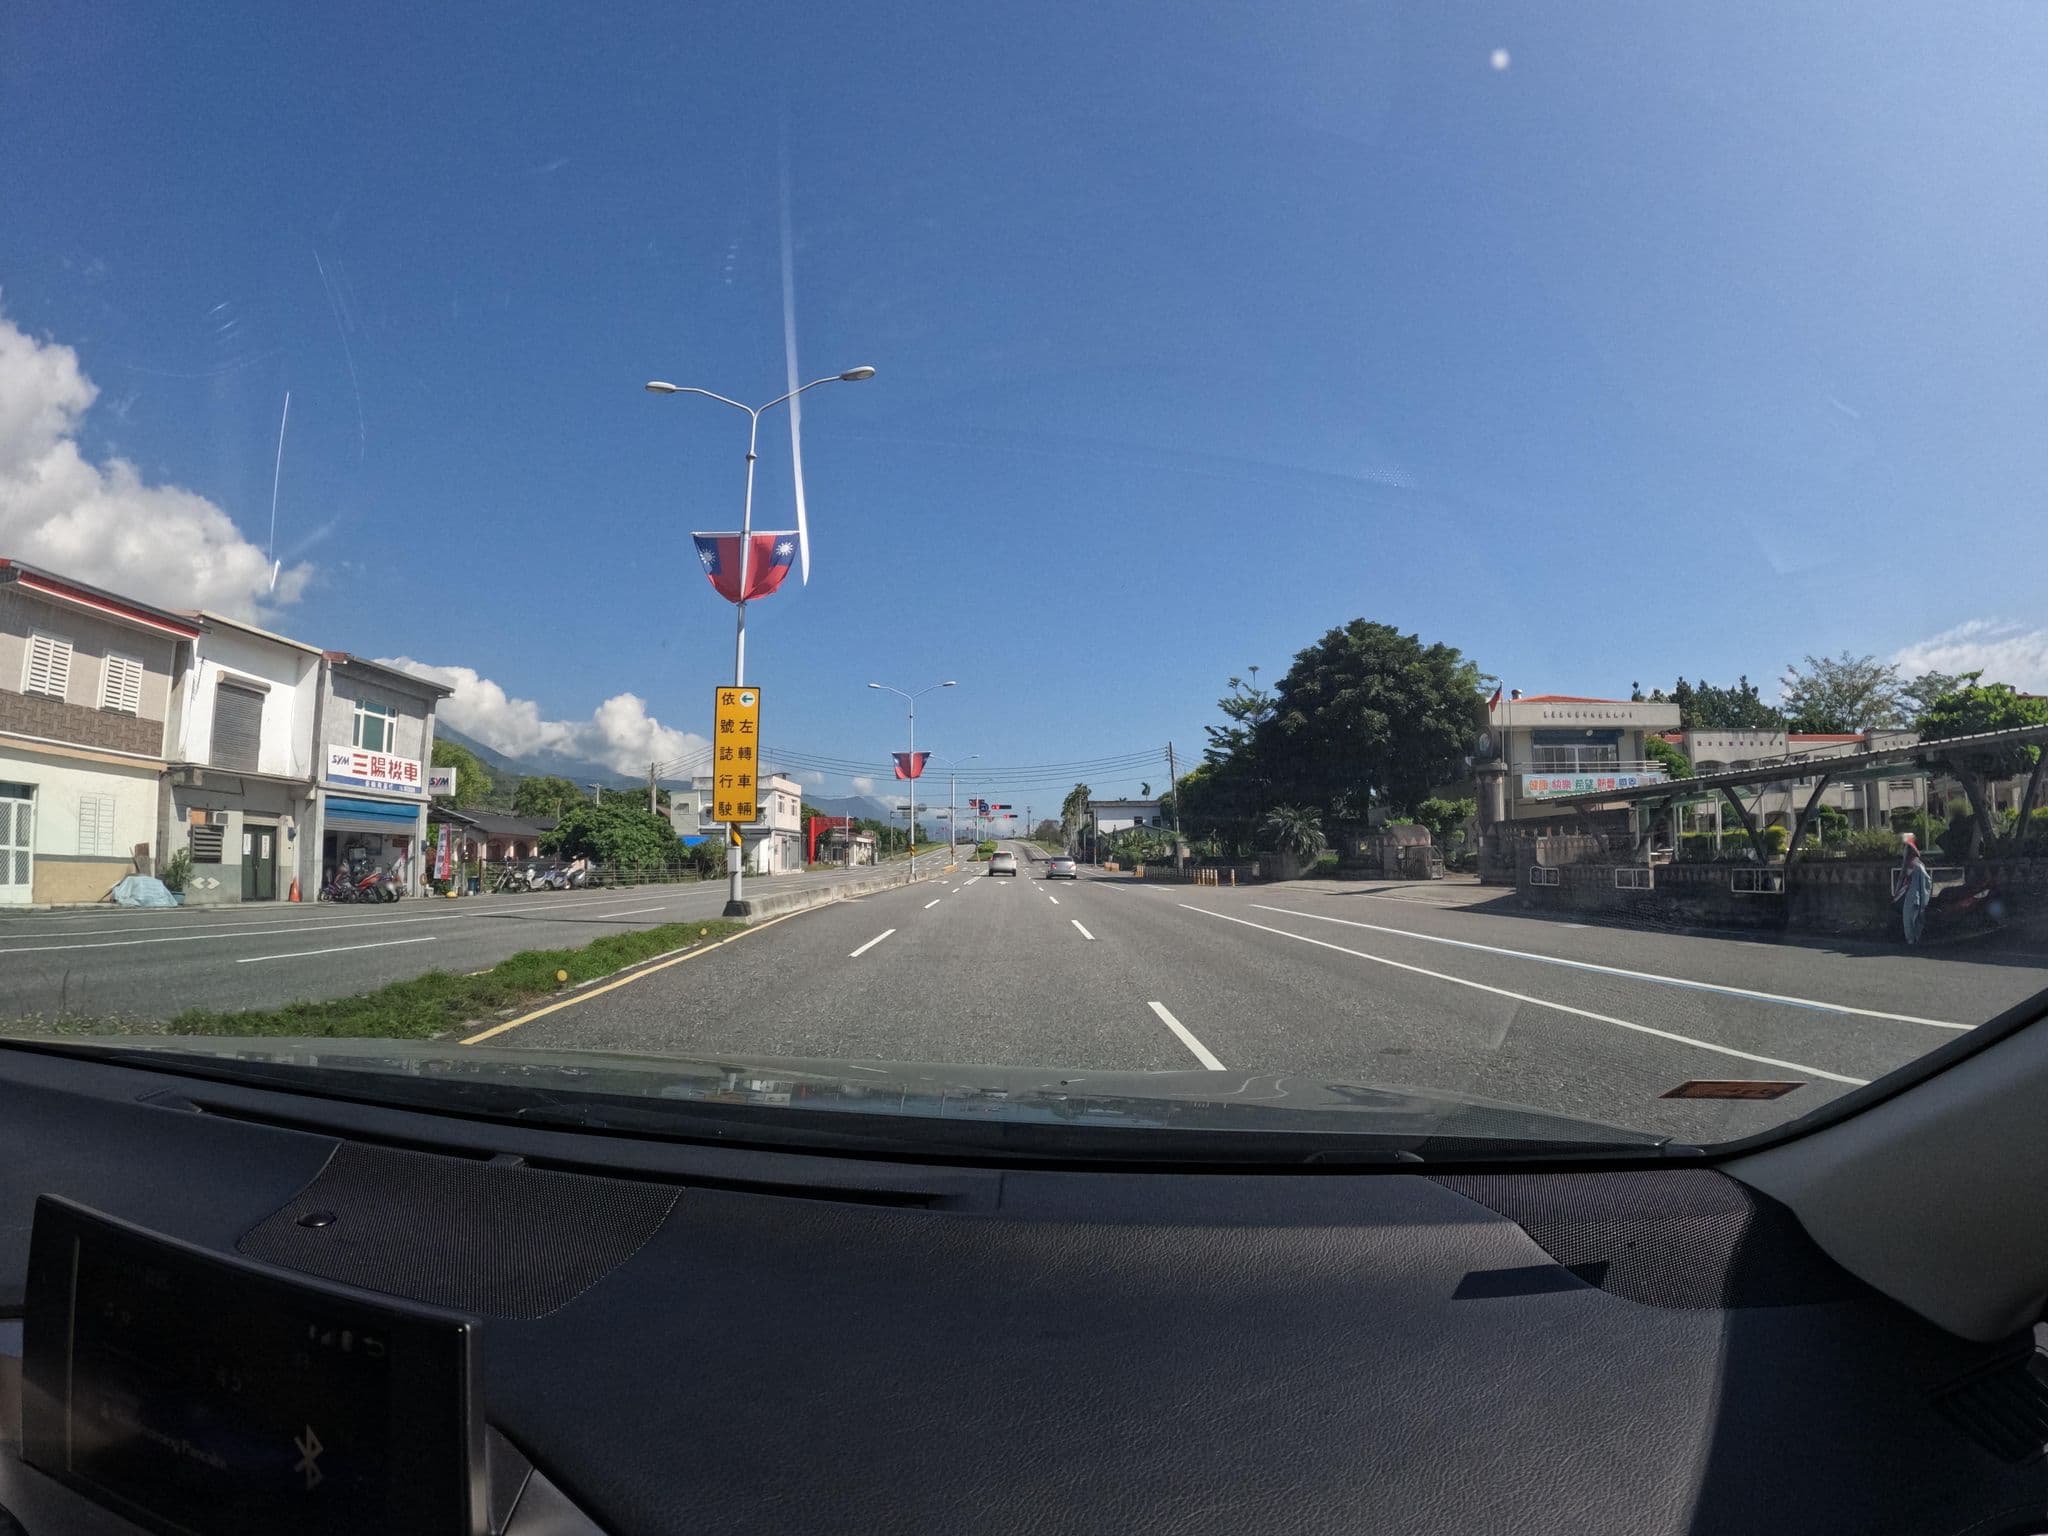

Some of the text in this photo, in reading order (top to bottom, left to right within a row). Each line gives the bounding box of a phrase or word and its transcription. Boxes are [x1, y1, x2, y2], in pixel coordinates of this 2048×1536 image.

[331, 754, 350, 766] SYM
[352, 753, 418, 783] 三陽機車
[718, 692, 735, 816] 依號誌行駛
[737, 719, 753, 816] 左轉車輛
[429, 777, 450, 786] SYM
